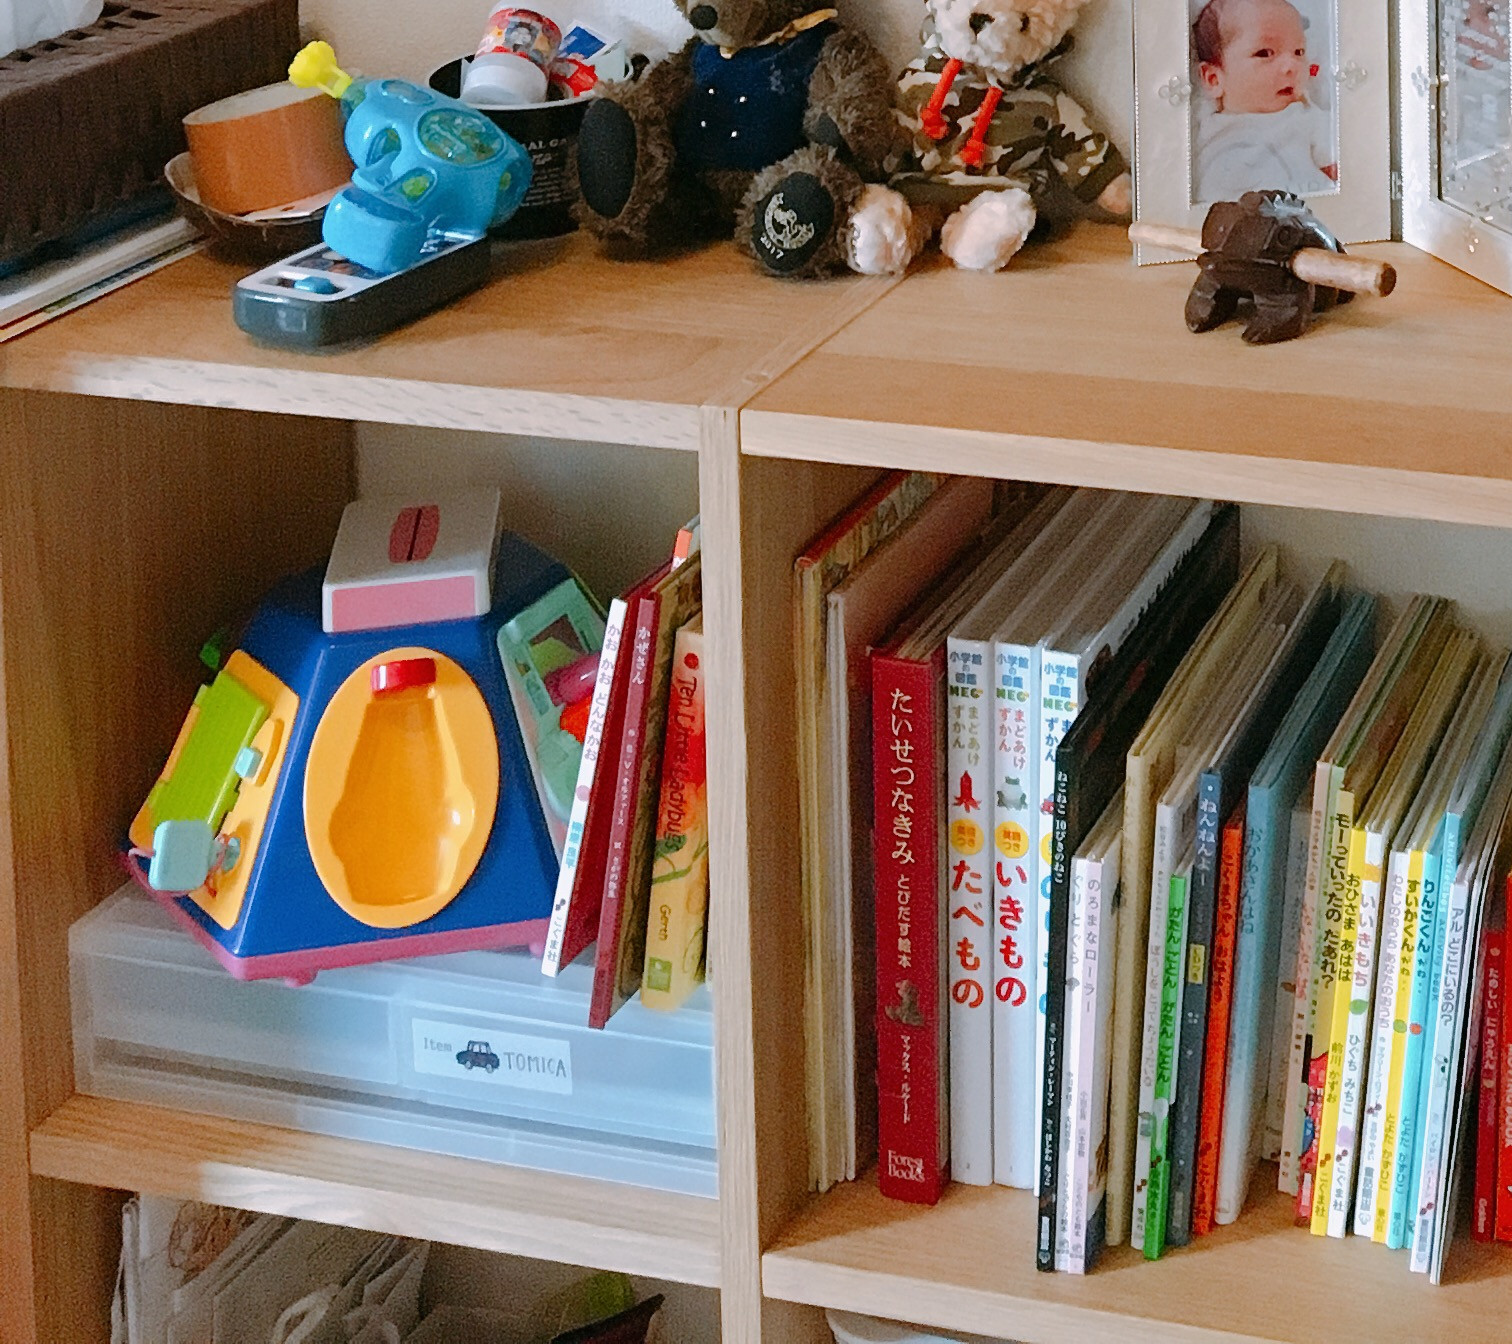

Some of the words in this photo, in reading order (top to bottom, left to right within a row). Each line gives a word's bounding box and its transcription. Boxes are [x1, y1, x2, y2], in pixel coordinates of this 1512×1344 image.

[605, 624, 621, 652] かお
[599, 658, 616, 686] かお
[677, 676, 698, 709] Ten
[889, 688, 916, 866] たいせつなきみ
[1056, 770, 1069, 815] ねこねこ
[1324, 813, 1350, 923] モーっていったの
[1071, 874, 1084, 965] ぐりとぐら
[1343, 873, 1361, 931] おひさま
[952, 859, 985, 1009] たべもの
[995, 860, 1028, 1008] いきもの
[1084, 878, 1101, 1013] のろまなローラー
[1338, 938, 1355, 983] あはは
[1353, 893, 1377, 988] いいきもち
[423, 1037, 453, 1052] Item
[503, 1051, 567, 1079] TOMICA
[888, 1164, 926, 1183] Books
